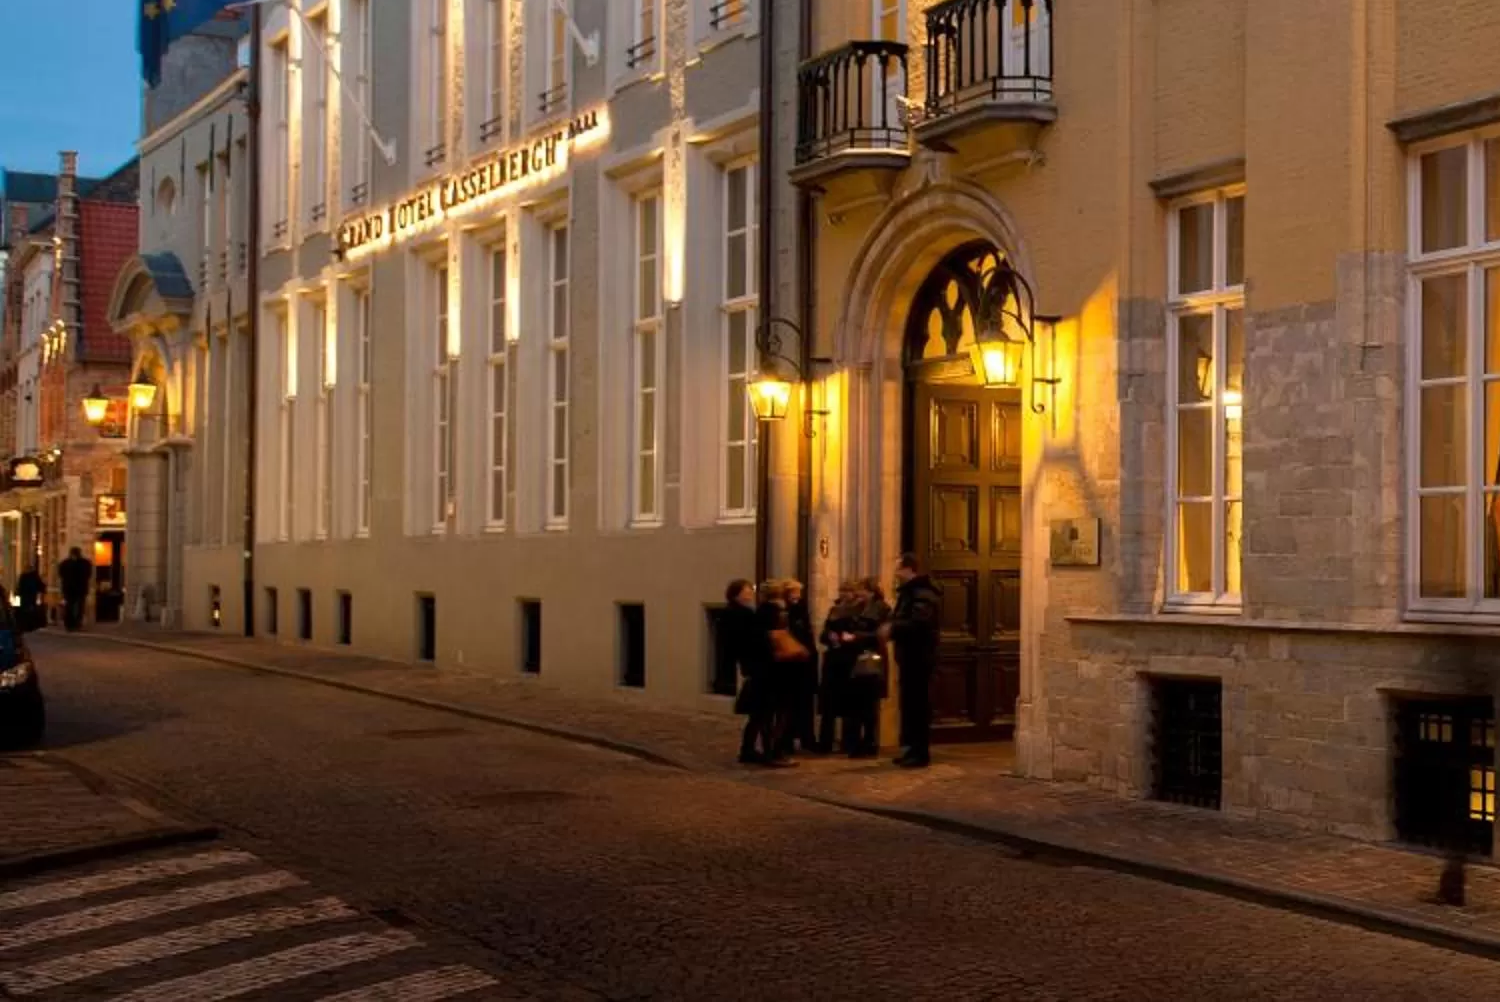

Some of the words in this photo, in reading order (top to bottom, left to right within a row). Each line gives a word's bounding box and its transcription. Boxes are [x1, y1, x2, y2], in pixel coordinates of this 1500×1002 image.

[337, 215, 383, 252] GRAND
[389, 190, 434, 233] HOTEL
[440, 135, 557, 211] CASSELBERGH
